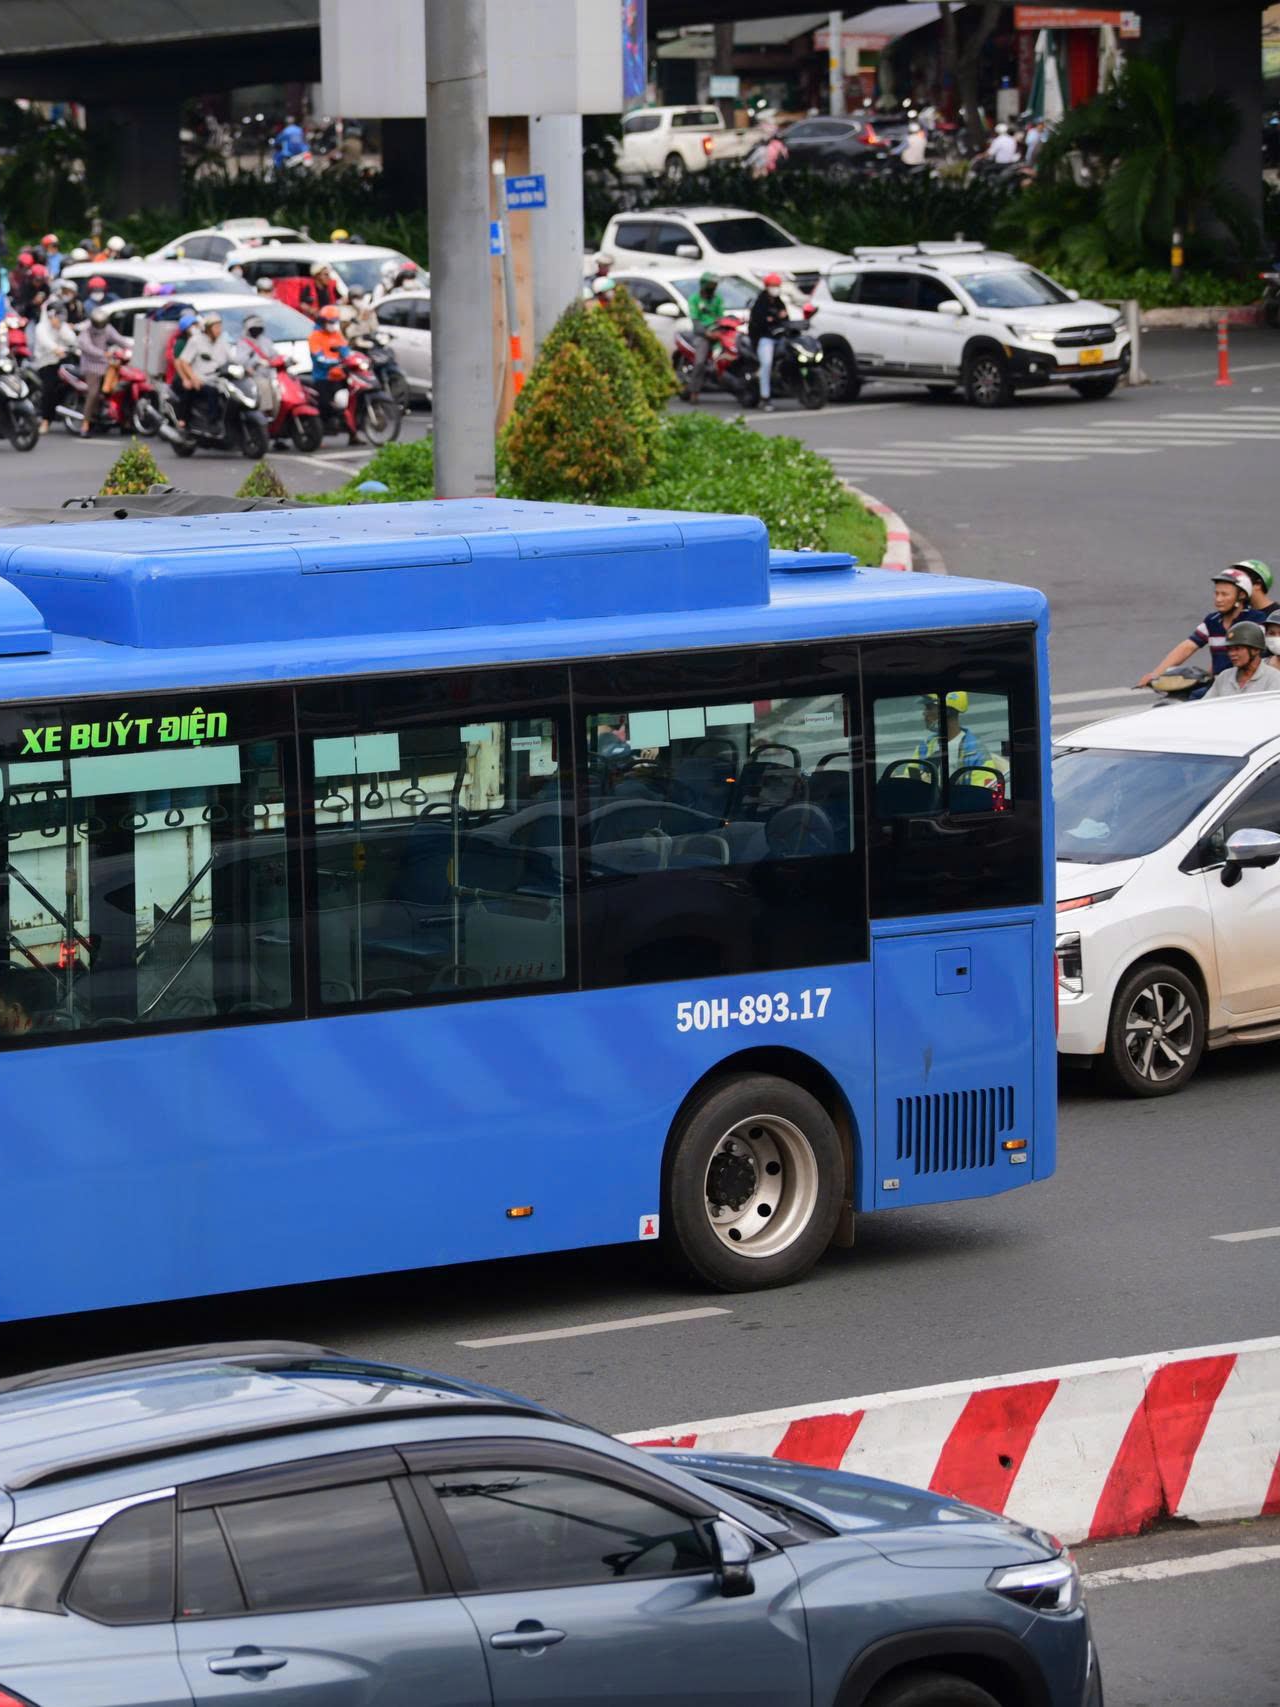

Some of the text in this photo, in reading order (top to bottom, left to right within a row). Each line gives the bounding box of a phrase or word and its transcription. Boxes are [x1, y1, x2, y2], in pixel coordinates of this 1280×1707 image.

[20, 706, 228, 755] XE BUÝT ĐIỆN
[676, 987, 832, 1033] 50H-893.17
